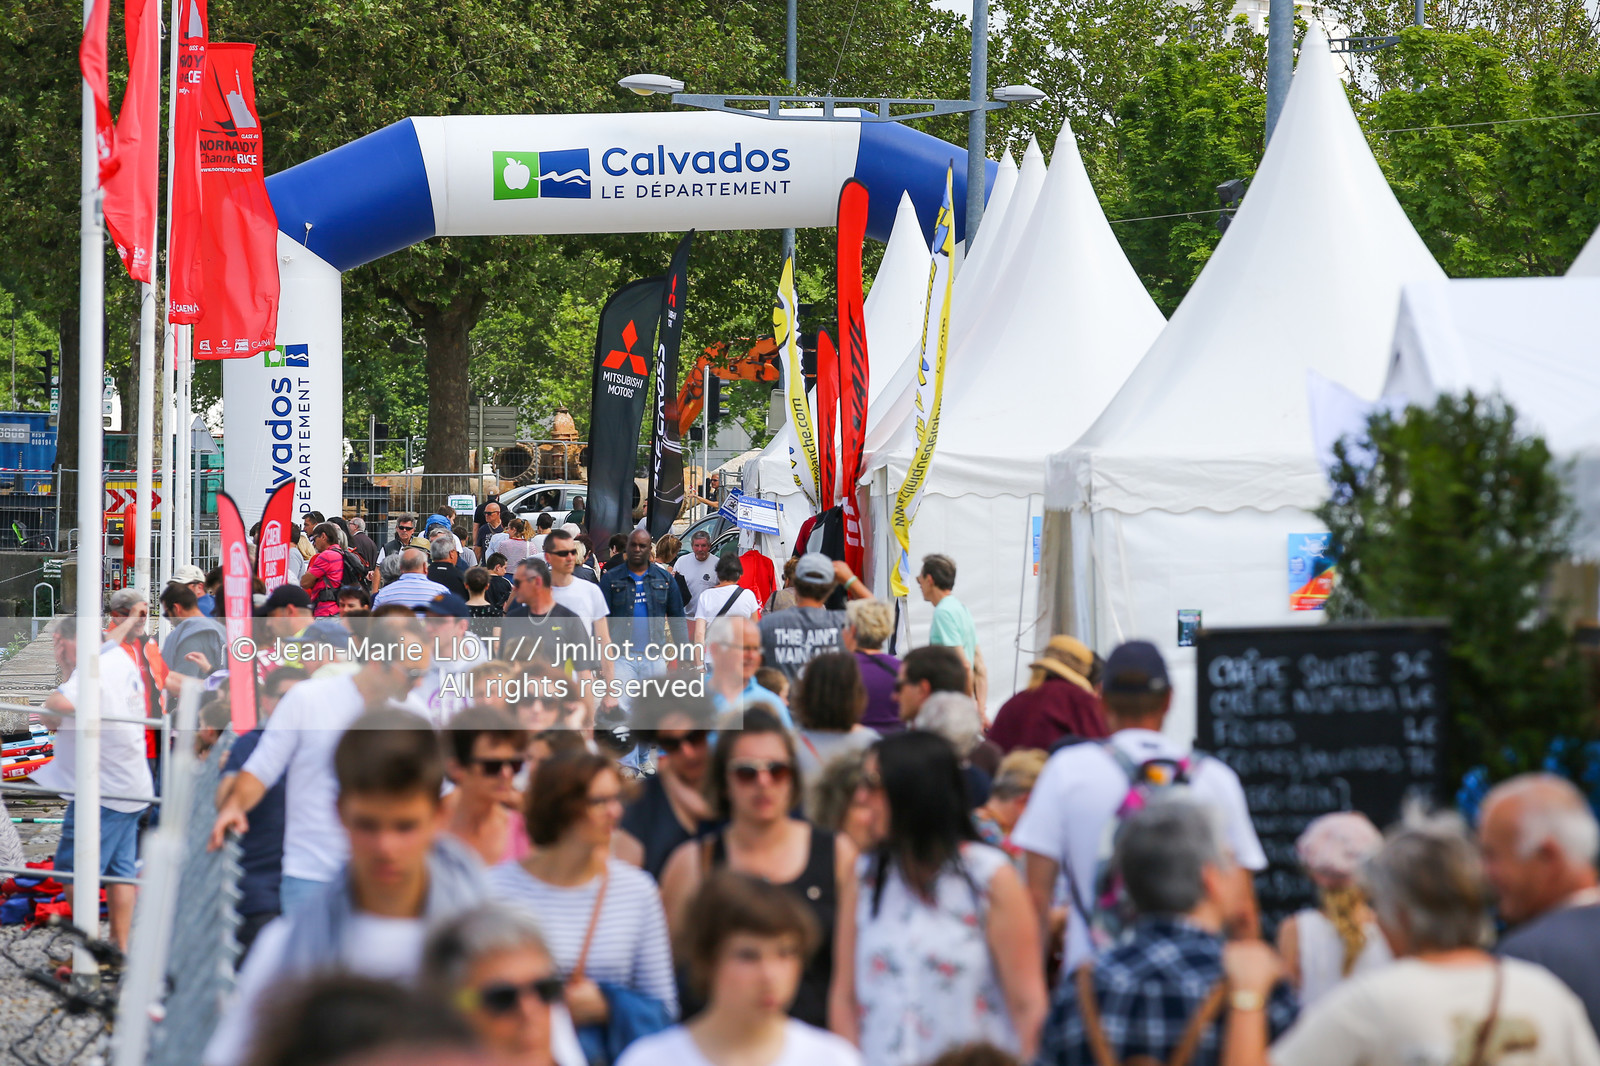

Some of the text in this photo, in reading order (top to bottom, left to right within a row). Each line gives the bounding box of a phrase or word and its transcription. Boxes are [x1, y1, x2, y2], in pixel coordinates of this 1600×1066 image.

[200, 140, 257, 152] NORMADY
[601, 142, 791, 176] Calvados
[601, 180, 791, 199] LE DÉPARTEMENT
[603, 371, 644, 388] MITSUBISHI
[607, 384, 634, 399] MOTORS
[265, 377, 293, 494] lvados
[297, 377, 311, 513] DÉPARTEMENT
